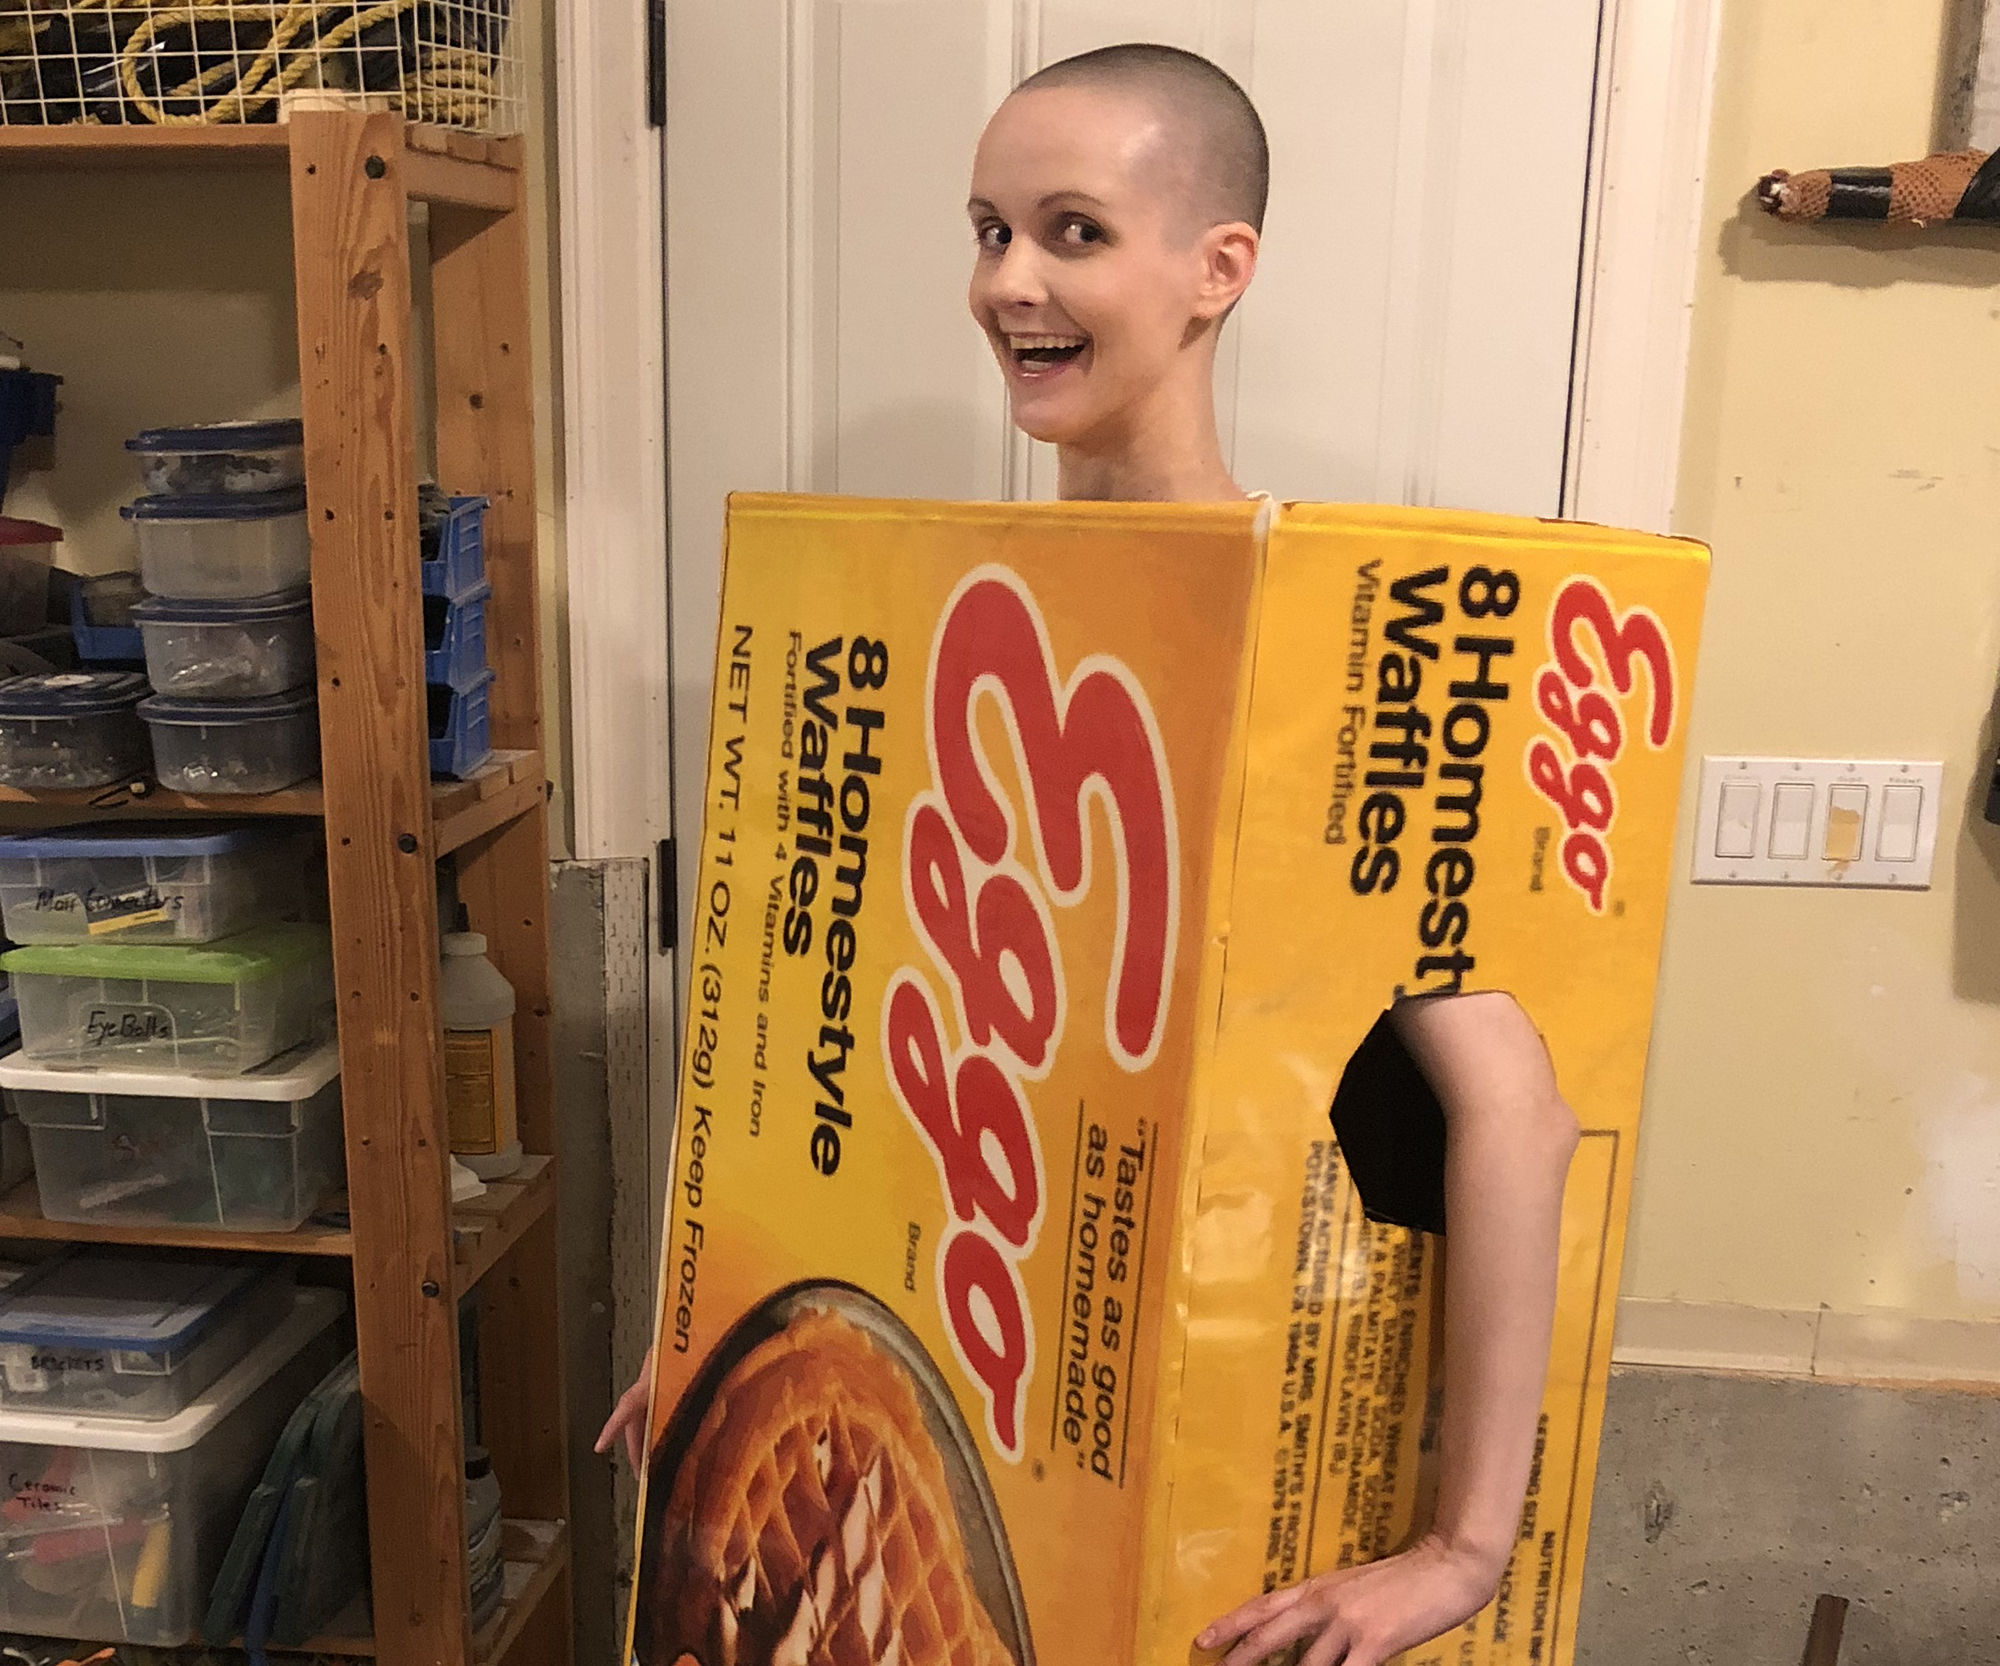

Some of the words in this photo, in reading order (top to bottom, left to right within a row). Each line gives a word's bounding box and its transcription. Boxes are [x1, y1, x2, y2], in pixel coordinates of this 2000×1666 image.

[1344, 559, 1382, 691] Vitamin
[1459, 565, 1520, 619] 8
[728, 625, 752, 724] NET
[781, 632, 801, 758] Fortified
[848, 636, 888, 691] 8
[719, 736, 745, 811] WT.
[1350, 564, 1449, 896] Waffles
[1522, 575, 1678, 914] Eggo
[775, 770, 794, 832] with
[782, 637, 842, 956] Waffles
[1324, 705, 1366, 845] Fortified
[1394, 635, 1514, 1001] Homesty
[716, 829, 736, 866] 11
[774, 842, 788, 860] 4
[1530, 827, 1551, 893] Brand
[705, 881, 730, 953] OZ.
[757, 875, 784, 1002] Vitamins
[807, 706, 885, 1177] Homestyle
[88, 1010, 116, 1046] Eye
[693, 963, 722, 1089] (312g)
[754, 1014, 769, 1070] and
[880, 563, 1180, 1464] Eggo
[750, 1080, 767, 1138] Iron
[1086, 1125, 1108, 1177] as
[685, 1106, 711, 1208] Keep
[675, 1220, 702, 1353] Frozen
[904, 1222, 922, 1291] Brand
[1102, 1297, 1124, 1349] as
[1090, 1362, 1118, 1480] good
[8, 1473, 76, 1495] Ceramic
[1281, 1502, 1301, 1582] FROZEN
[1532, 1531, 1556, 1631] NUTRITION
